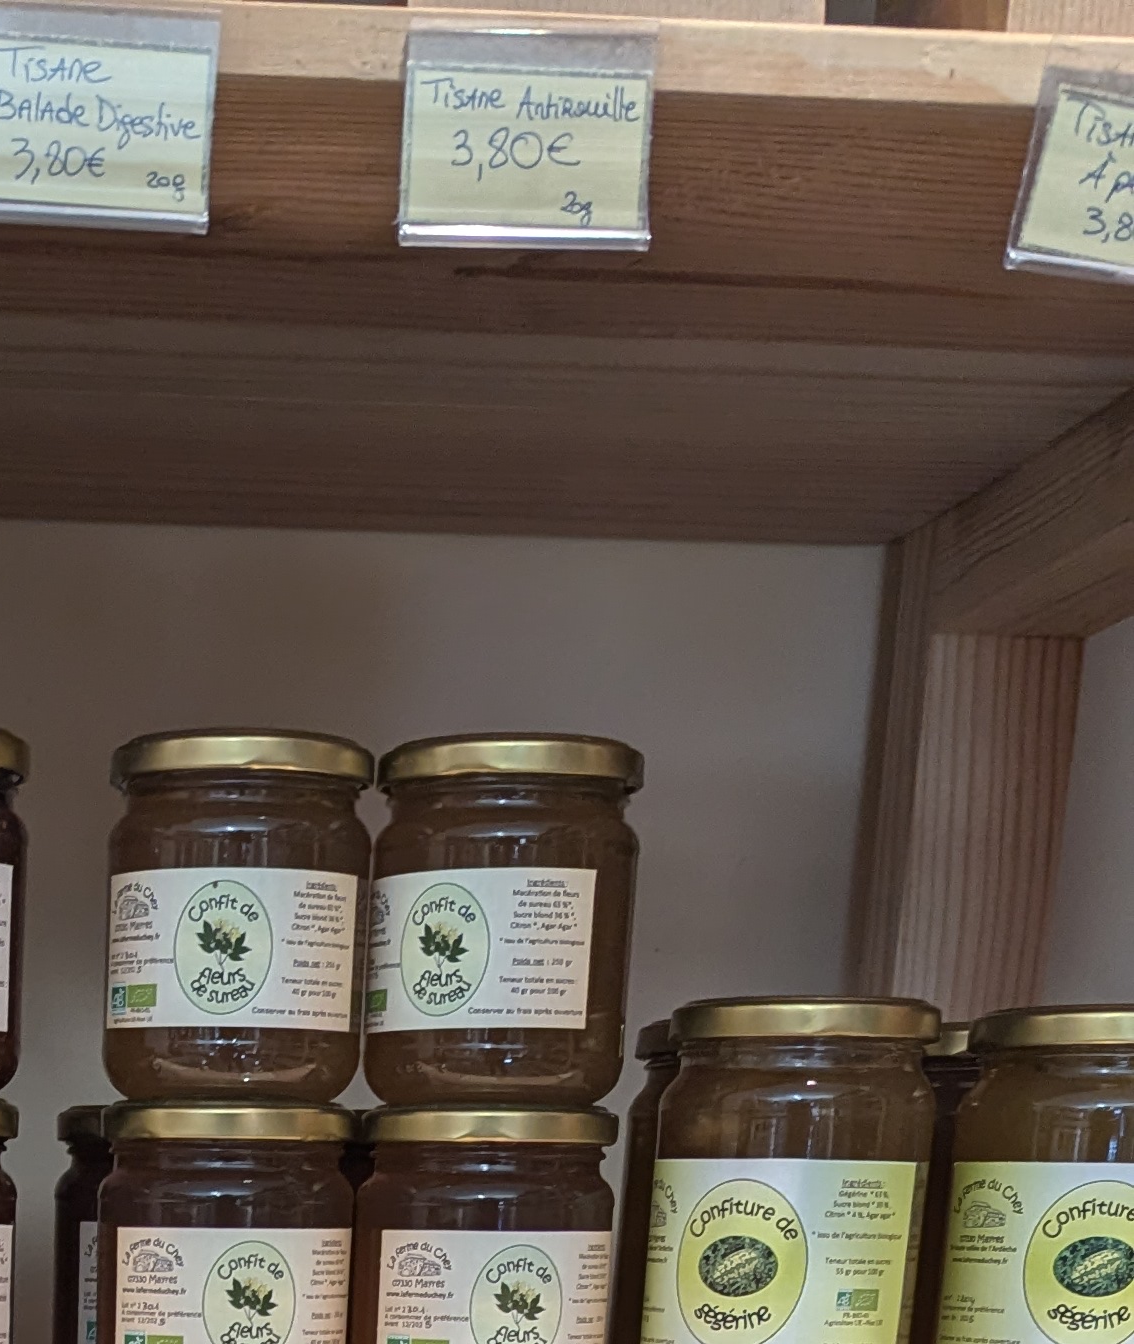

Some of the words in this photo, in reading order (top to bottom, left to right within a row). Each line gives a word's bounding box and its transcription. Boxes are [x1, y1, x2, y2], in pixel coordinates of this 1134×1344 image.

[421, 77, 506, 111] Tisane
[96, 94, 202, 150] Digestive
[451, 126, 582, 182] 3,80€
[690, 1197, 775, 1238] Confiture
[775, 1213, 799, 1241] de
[486, 1258, 533, 1283] Confit
[536, 1266, 553, 1284] de
[494, 1326, 540, 1343] fleurs
